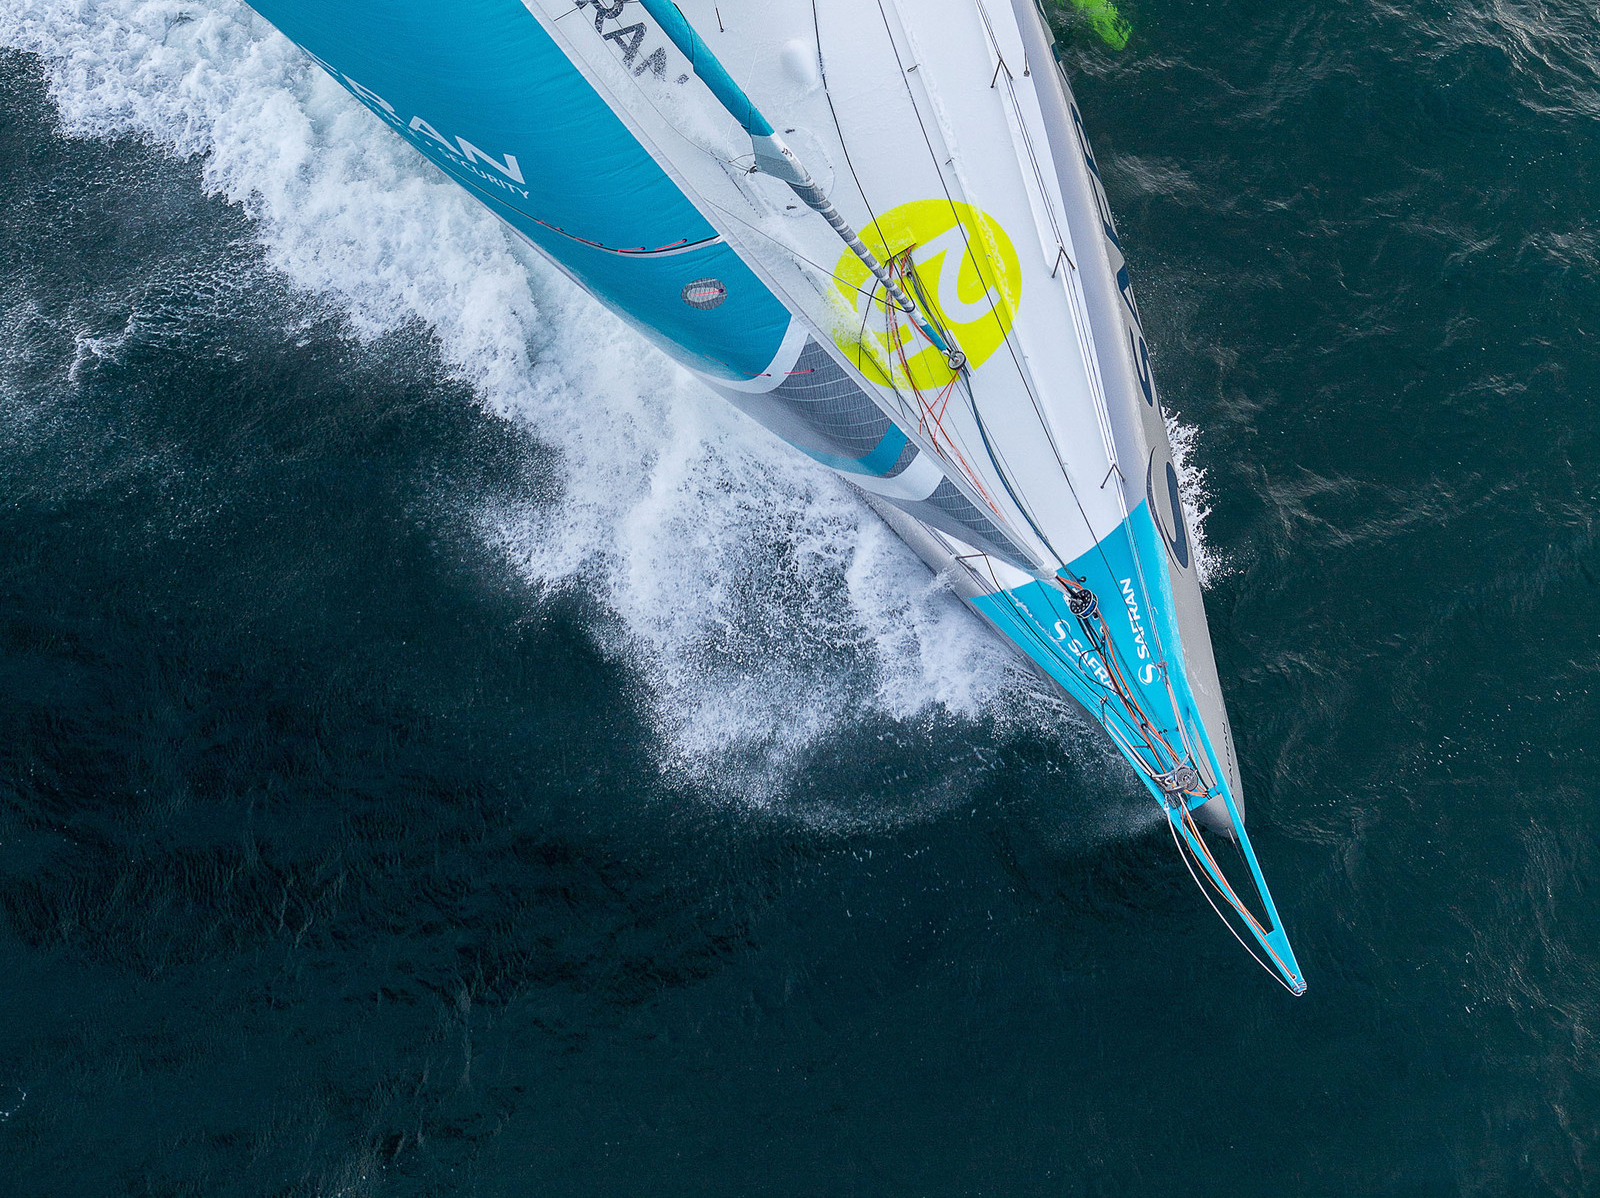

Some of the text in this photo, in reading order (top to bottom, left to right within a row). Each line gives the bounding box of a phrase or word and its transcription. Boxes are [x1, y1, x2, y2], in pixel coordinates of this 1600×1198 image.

[437, 147, 529, 199] SECURITY
[1120, 578, 1150, 659] SAFRAN
[1067, 638, 1130, 699] SAFRA
